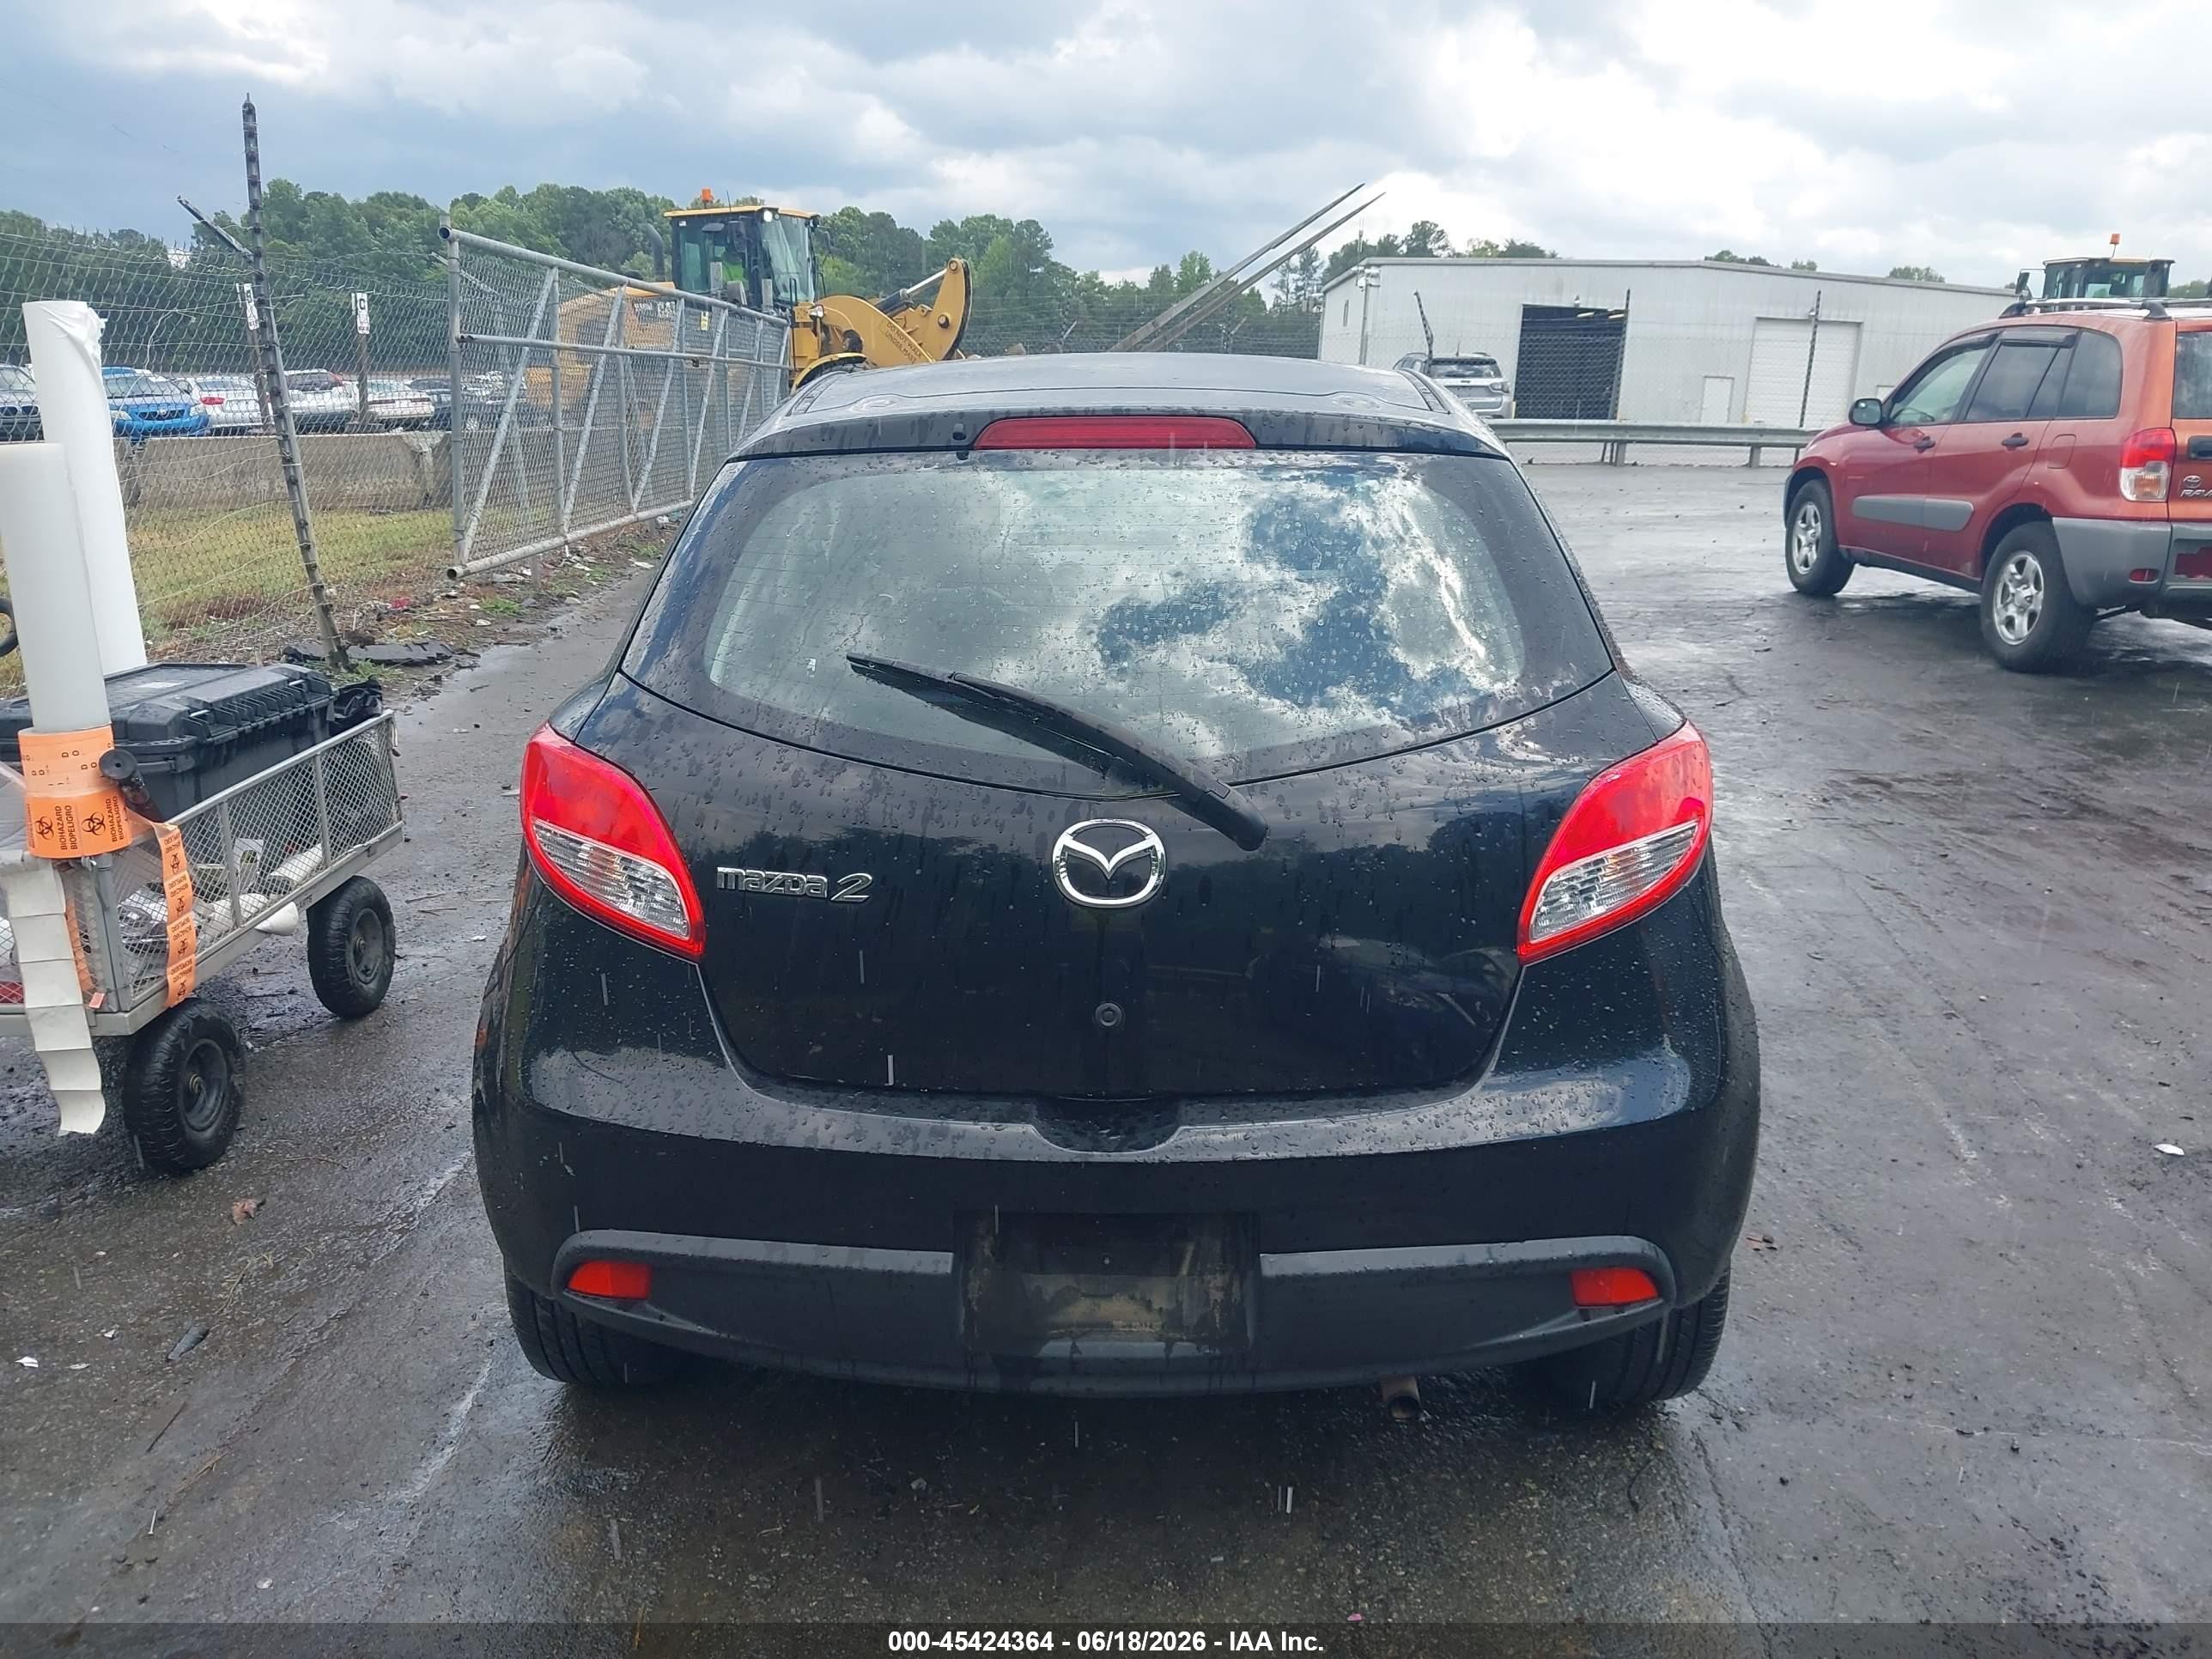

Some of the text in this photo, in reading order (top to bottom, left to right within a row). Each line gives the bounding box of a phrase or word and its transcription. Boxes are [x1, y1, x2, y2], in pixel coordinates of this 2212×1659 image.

[55, 805, 68, 850] BIOHAZARD
[64, 805, 78, 850] BIOPELIGRO
[106, 798, 118, 842] BIOHAZARD
[112, 795, 125, 841] BIOPELIGRO
[830, 872, 873, 902] 2
